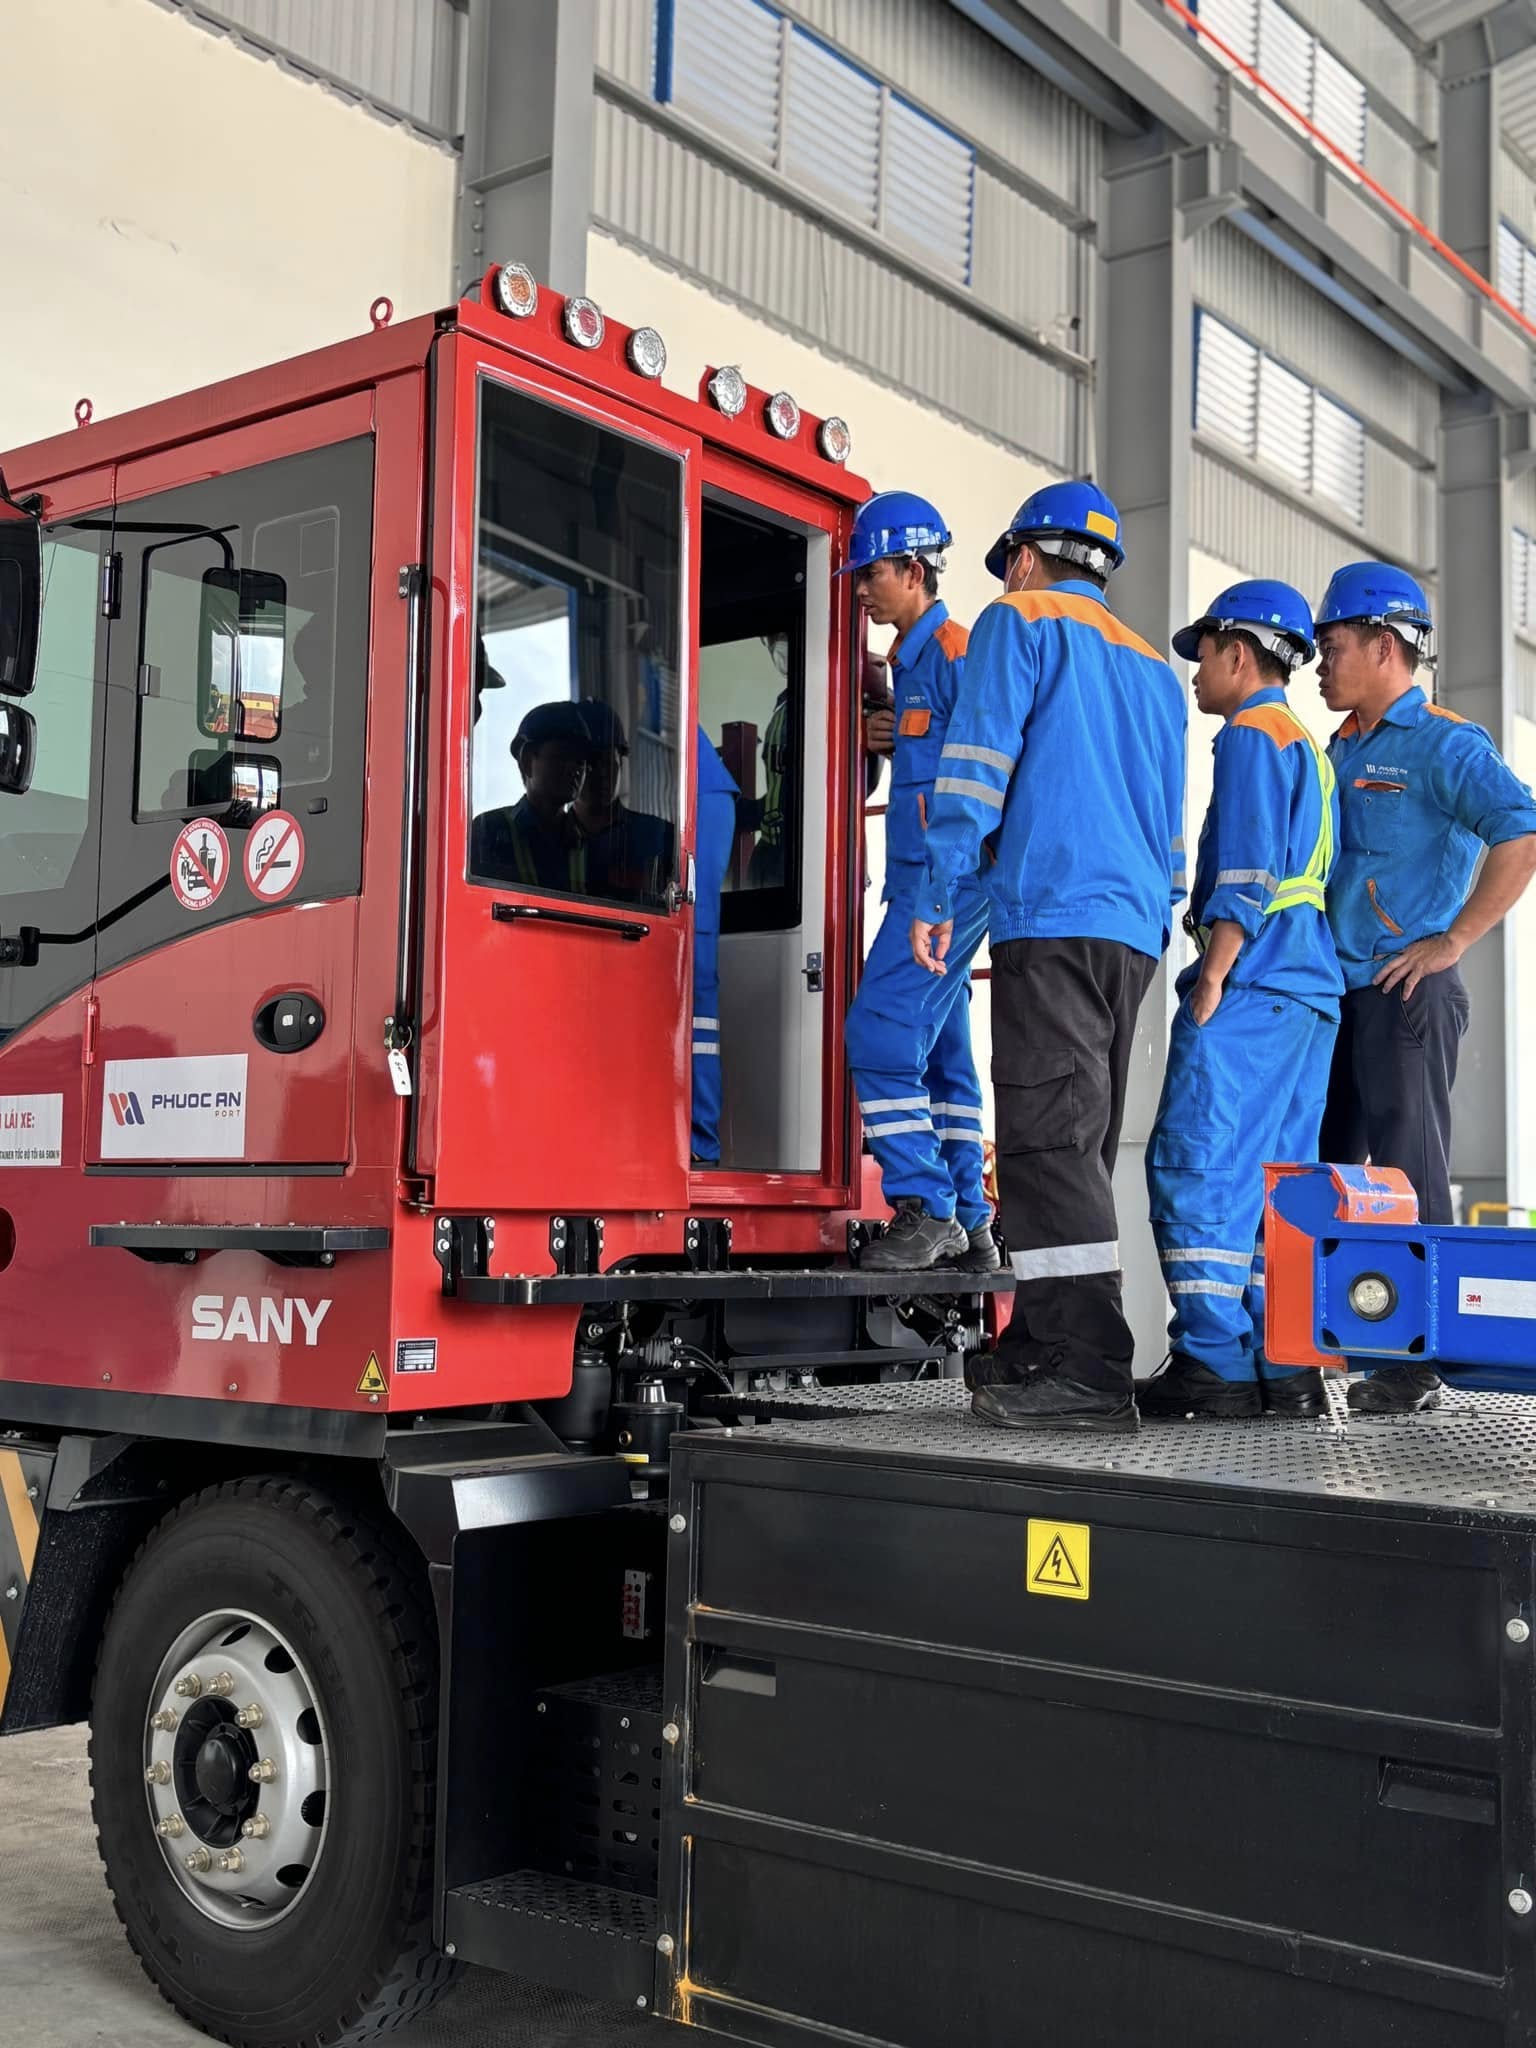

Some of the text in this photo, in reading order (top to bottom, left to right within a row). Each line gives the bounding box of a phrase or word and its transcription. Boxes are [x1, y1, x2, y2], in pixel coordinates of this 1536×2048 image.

[152, 1092, 241, 1109] PHUOC AN
[4, 1108, 18, 1129] LÁI
[20, 1111, 35, 1129] XE:
[215, 1109, 240, 1118] PORT
[1466, 1294, 1482, 1303] 3M
[191, 1295, 332, 1346] SANY
